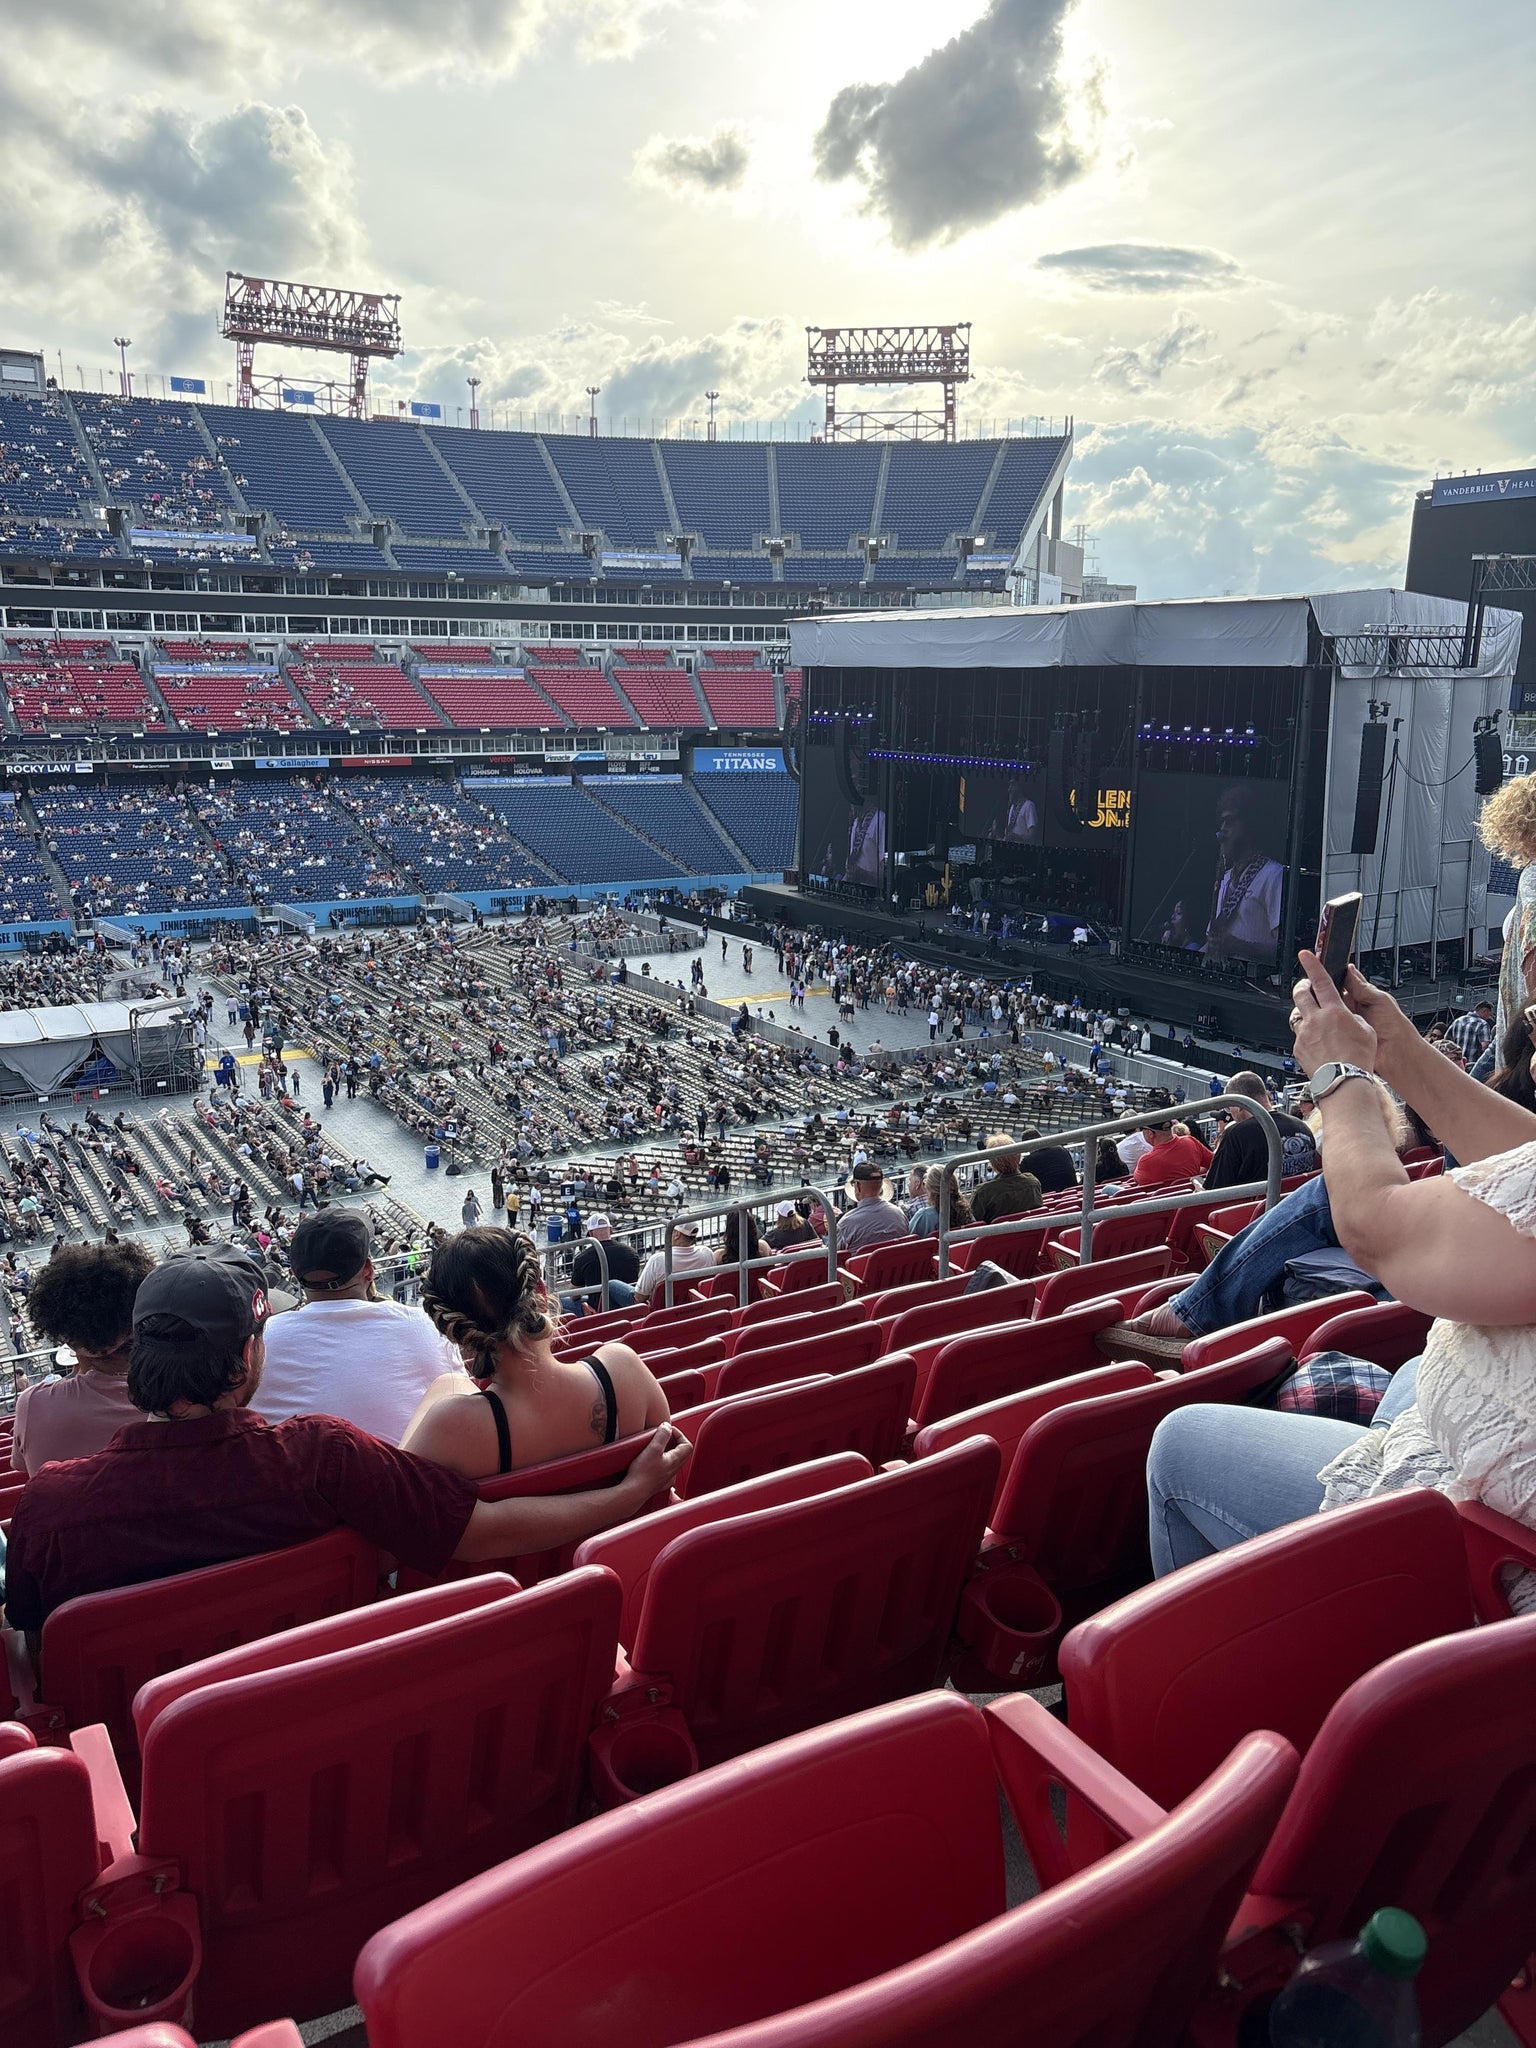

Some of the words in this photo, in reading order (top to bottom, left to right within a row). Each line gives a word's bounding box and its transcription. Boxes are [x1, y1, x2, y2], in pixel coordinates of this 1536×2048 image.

[1442, 484, 1495, 496] VANDERBILT
[1511, 480, 1536, 489] HEAL
[280, 759, 319, 767] Gallagher
[712, 758, 777, 770] TITANS
[6, 764, 45, 774] ROCKY
[47, 764, 71, 773] LAW
[160, 917, 203, 931] TENNESSEE
[564, 1187, 571, 1195] E
